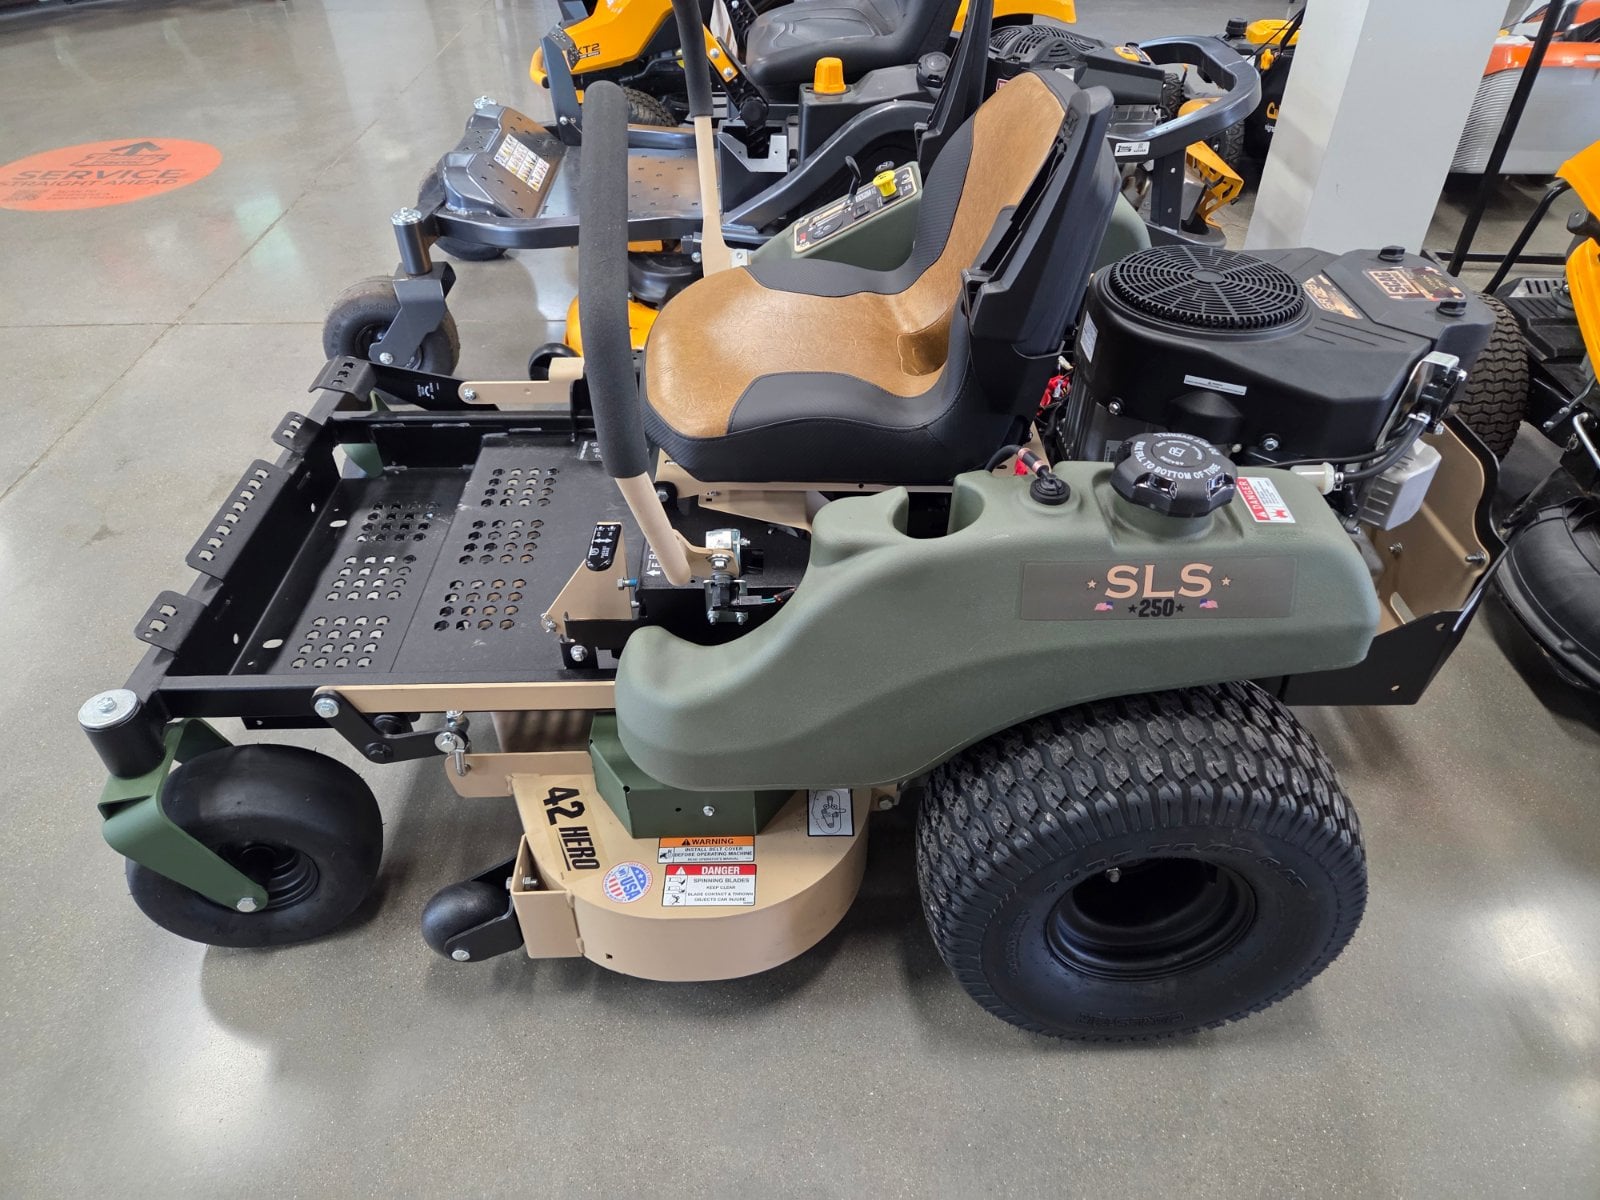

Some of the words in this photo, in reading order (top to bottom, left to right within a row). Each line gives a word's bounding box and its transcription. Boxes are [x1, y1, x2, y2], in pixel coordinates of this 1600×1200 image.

[13, 169, 187, 180] SERVICE
[1373, 272, 1406, 293] SCAG
[1134, 450, 1147, 462] FILL
[1143, 460, 1155, 469] TO
[1154, 466, 1192, 480] BOTTOM
[1193, 470, 1205, 479] OF
[1238, 480, 1263, 510] DANGER
[1104, 563, 1213, 599] SLS
[1138, 598, 1175, 617] 250
[543, 787, 585, 826] 42
[558, 826, 600, 869] HERO
[701, 866, 740, 875] DANGER
[620, 875, 641, 900] USA
